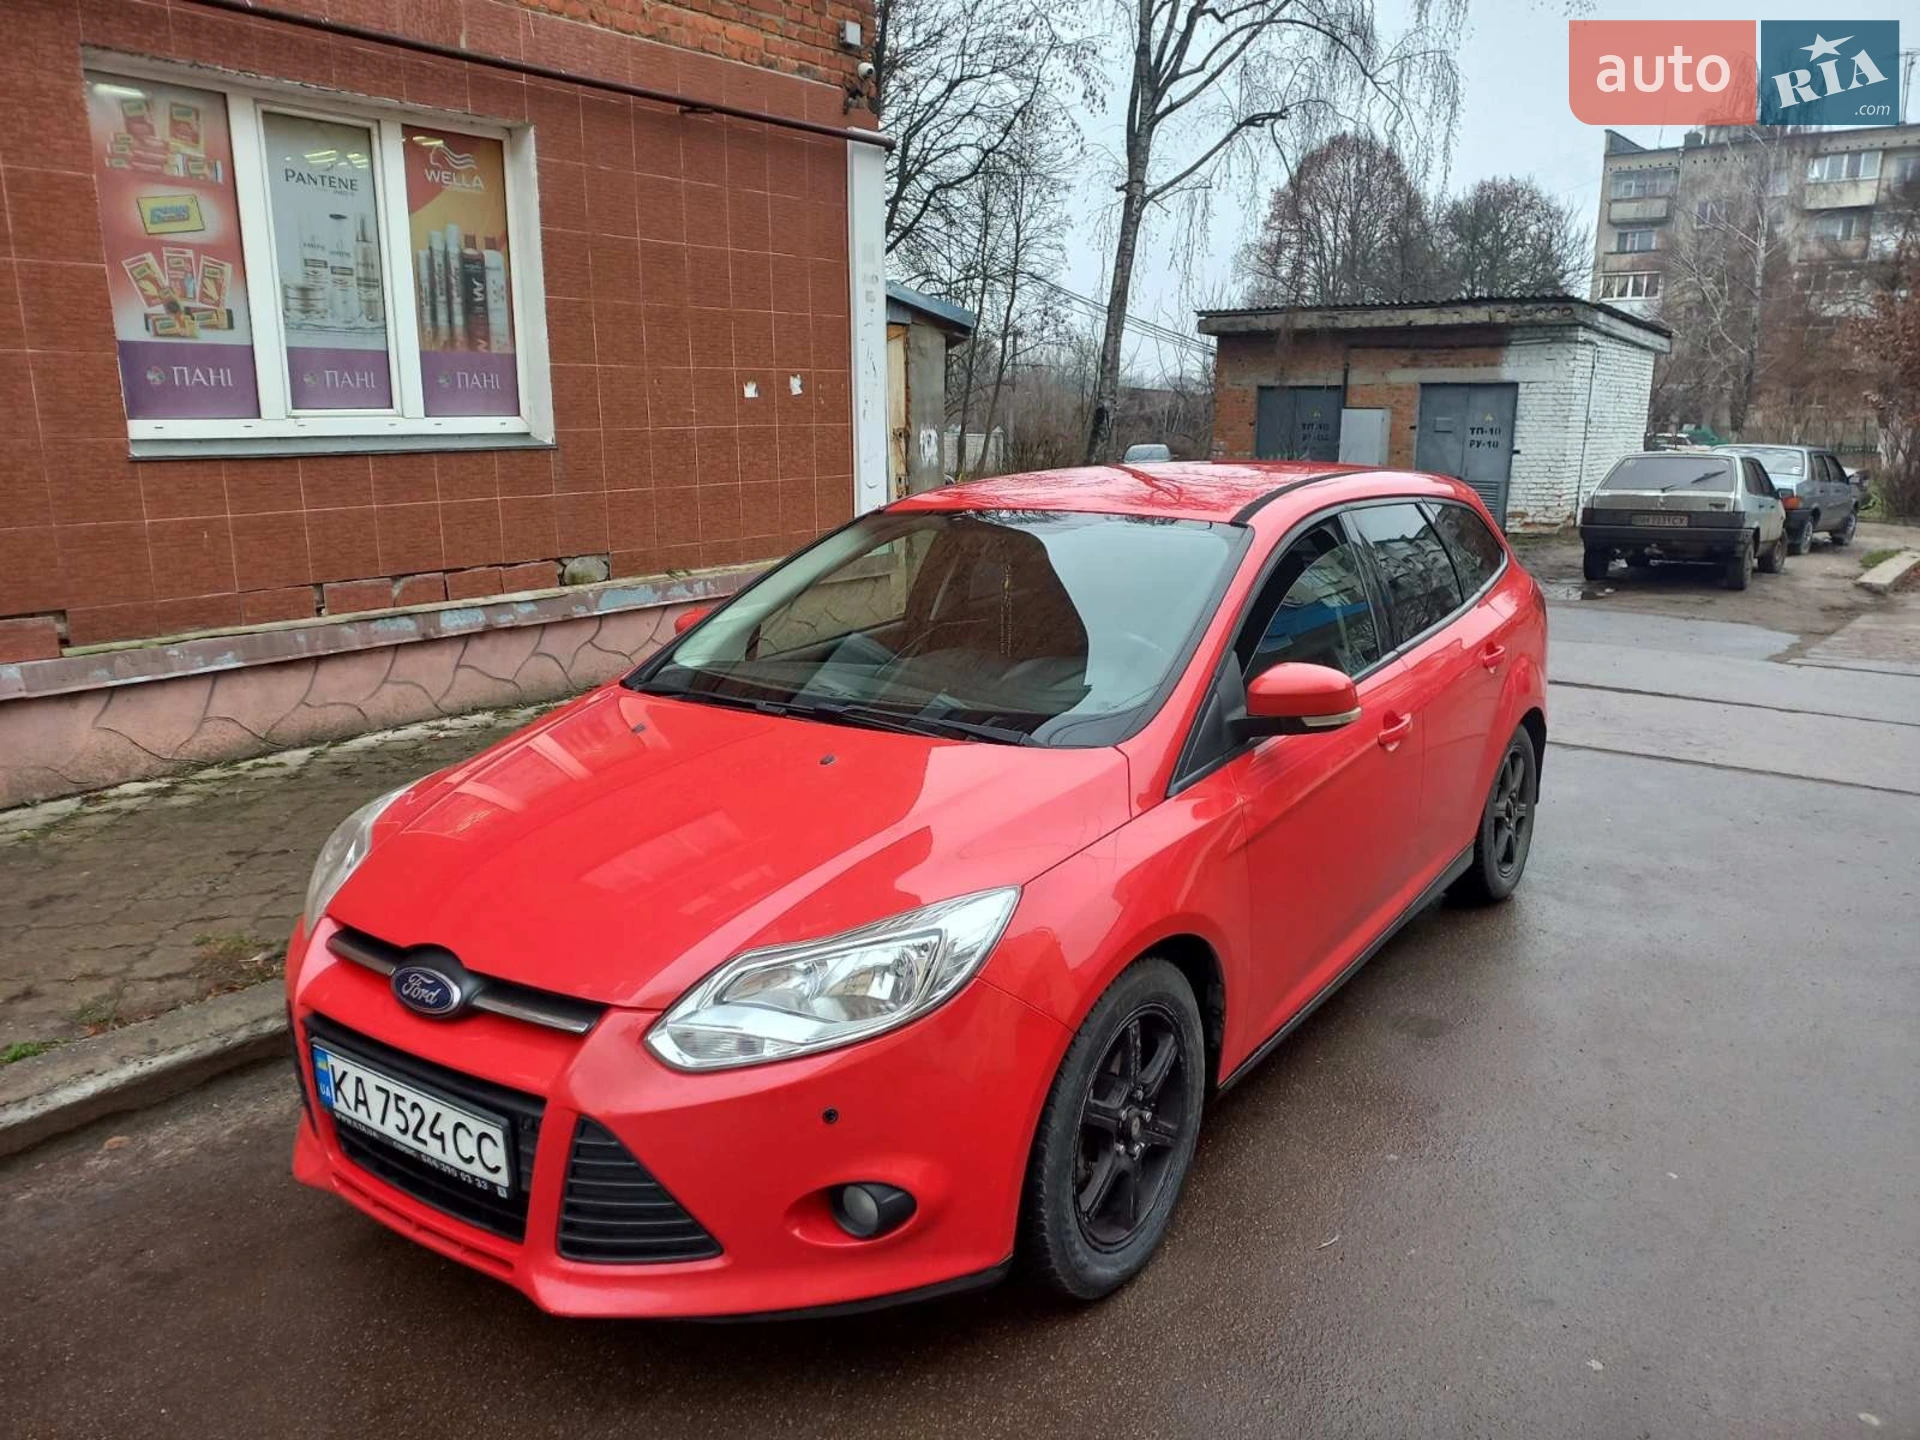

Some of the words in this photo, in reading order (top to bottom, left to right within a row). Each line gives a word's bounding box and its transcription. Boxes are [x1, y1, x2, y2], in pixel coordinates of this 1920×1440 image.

[284, 168, 359, 192] PANTENE
[424, 168, 486, 191] WELLA
[173, 365, 233, 387] ПАНІ
[325, 370, 376, 389] ПАНІ
[456, 371, 500, 390] ПАНІ
[402, 973, 442, 1005] Ford
